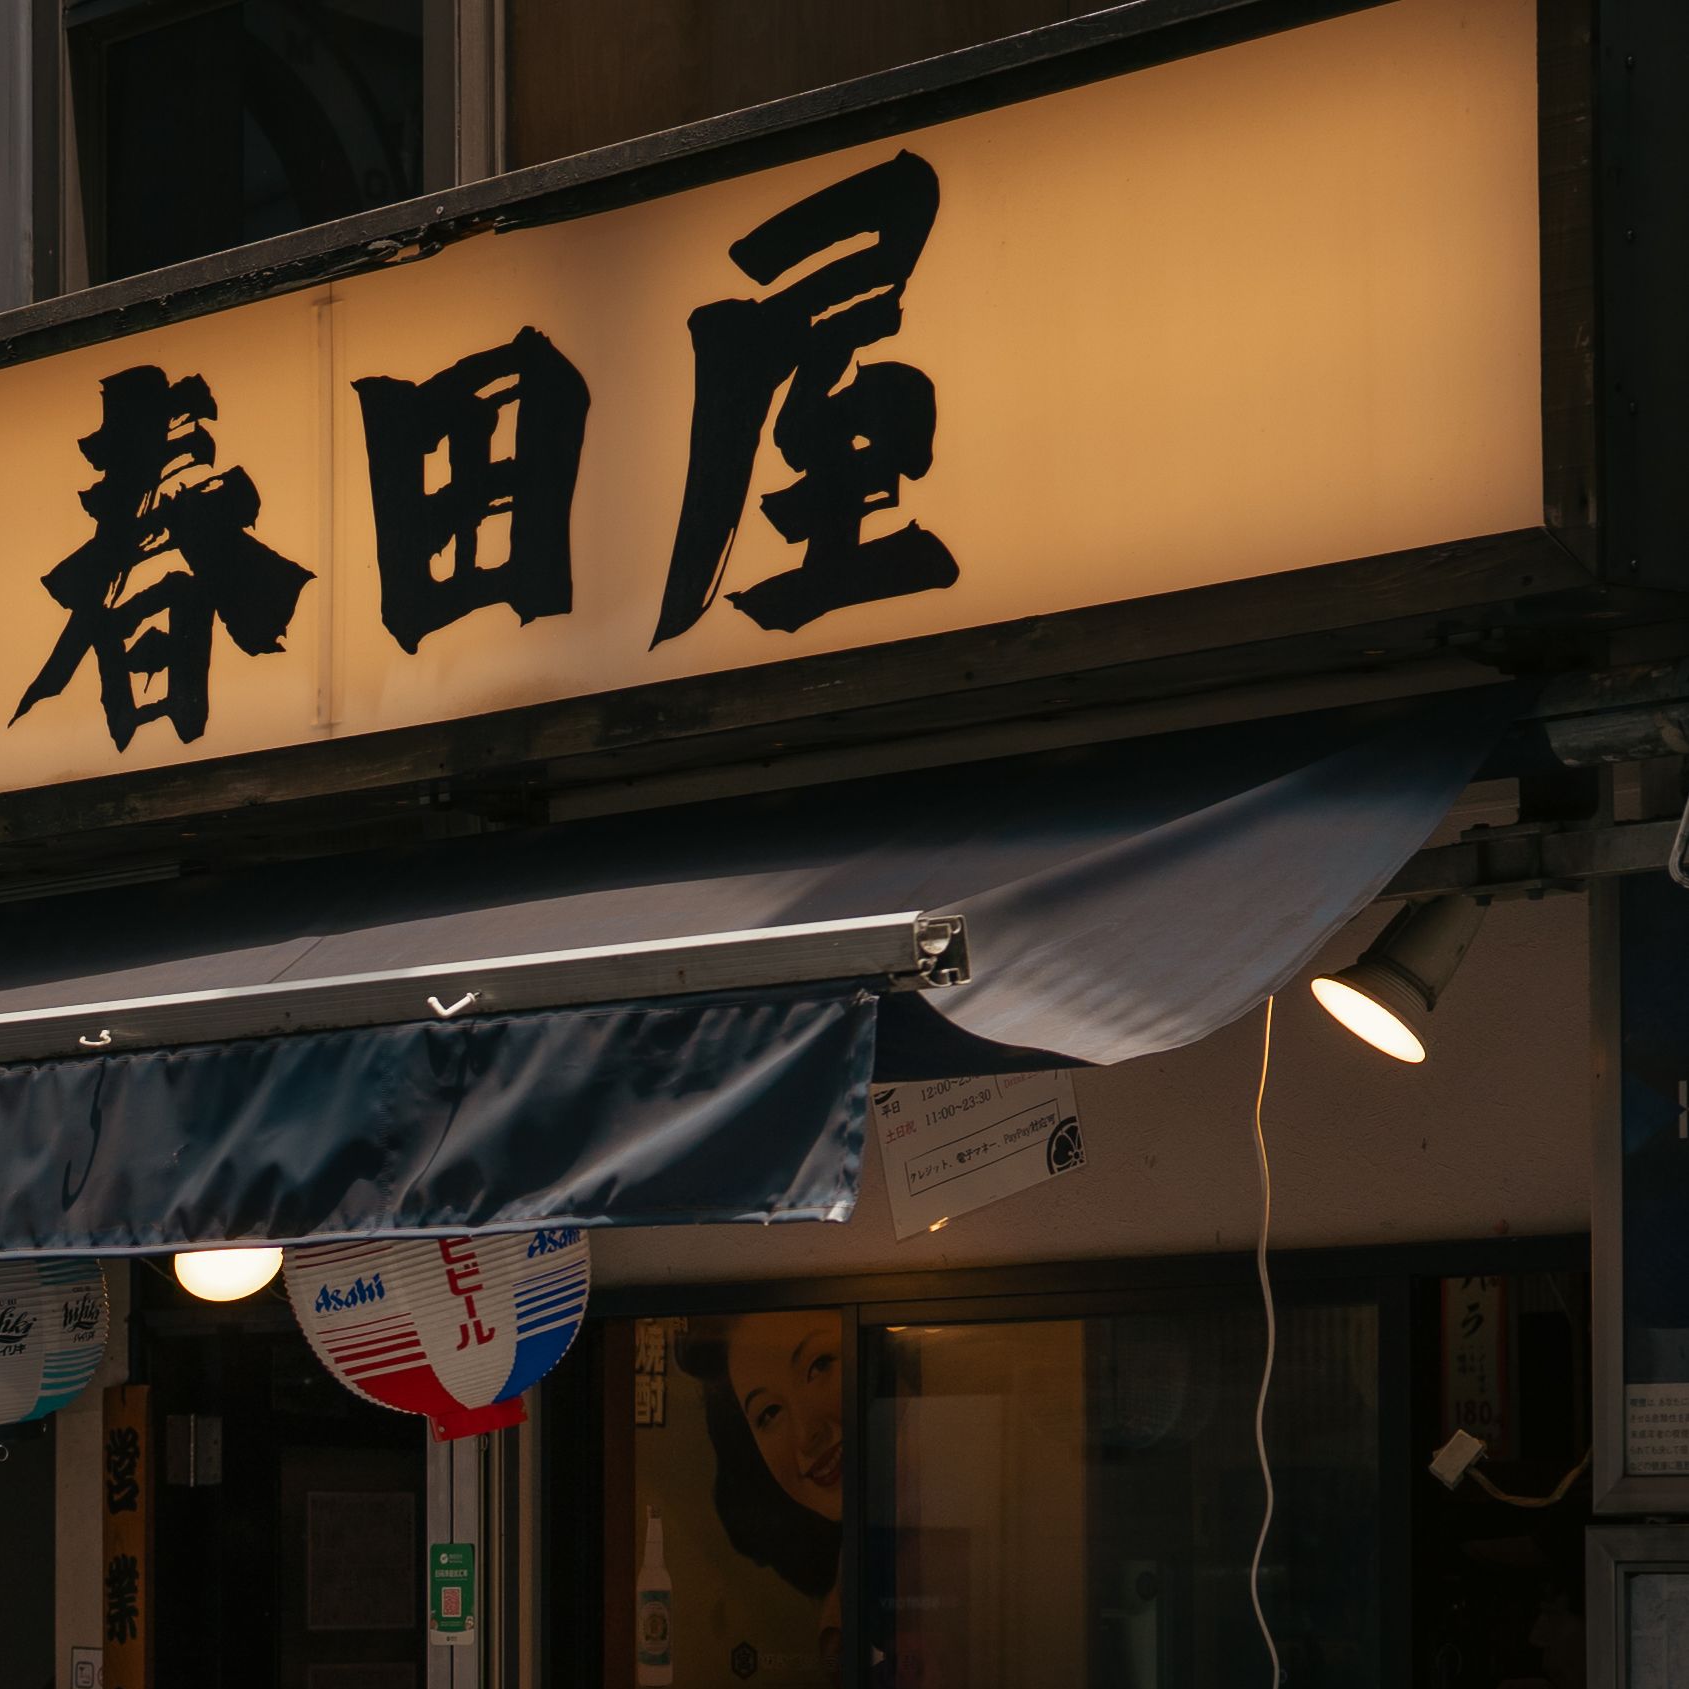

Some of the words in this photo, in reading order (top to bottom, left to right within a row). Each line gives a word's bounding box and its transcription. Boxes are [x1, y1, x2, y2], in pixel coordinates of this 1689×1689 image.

[8, 149, 962, 753] 春田屋
[881, 1101, 901, 1117] 平日
[885, 1120, 917, 1145] 土日祝
[315, 1273, 387, 1315] Asahi
